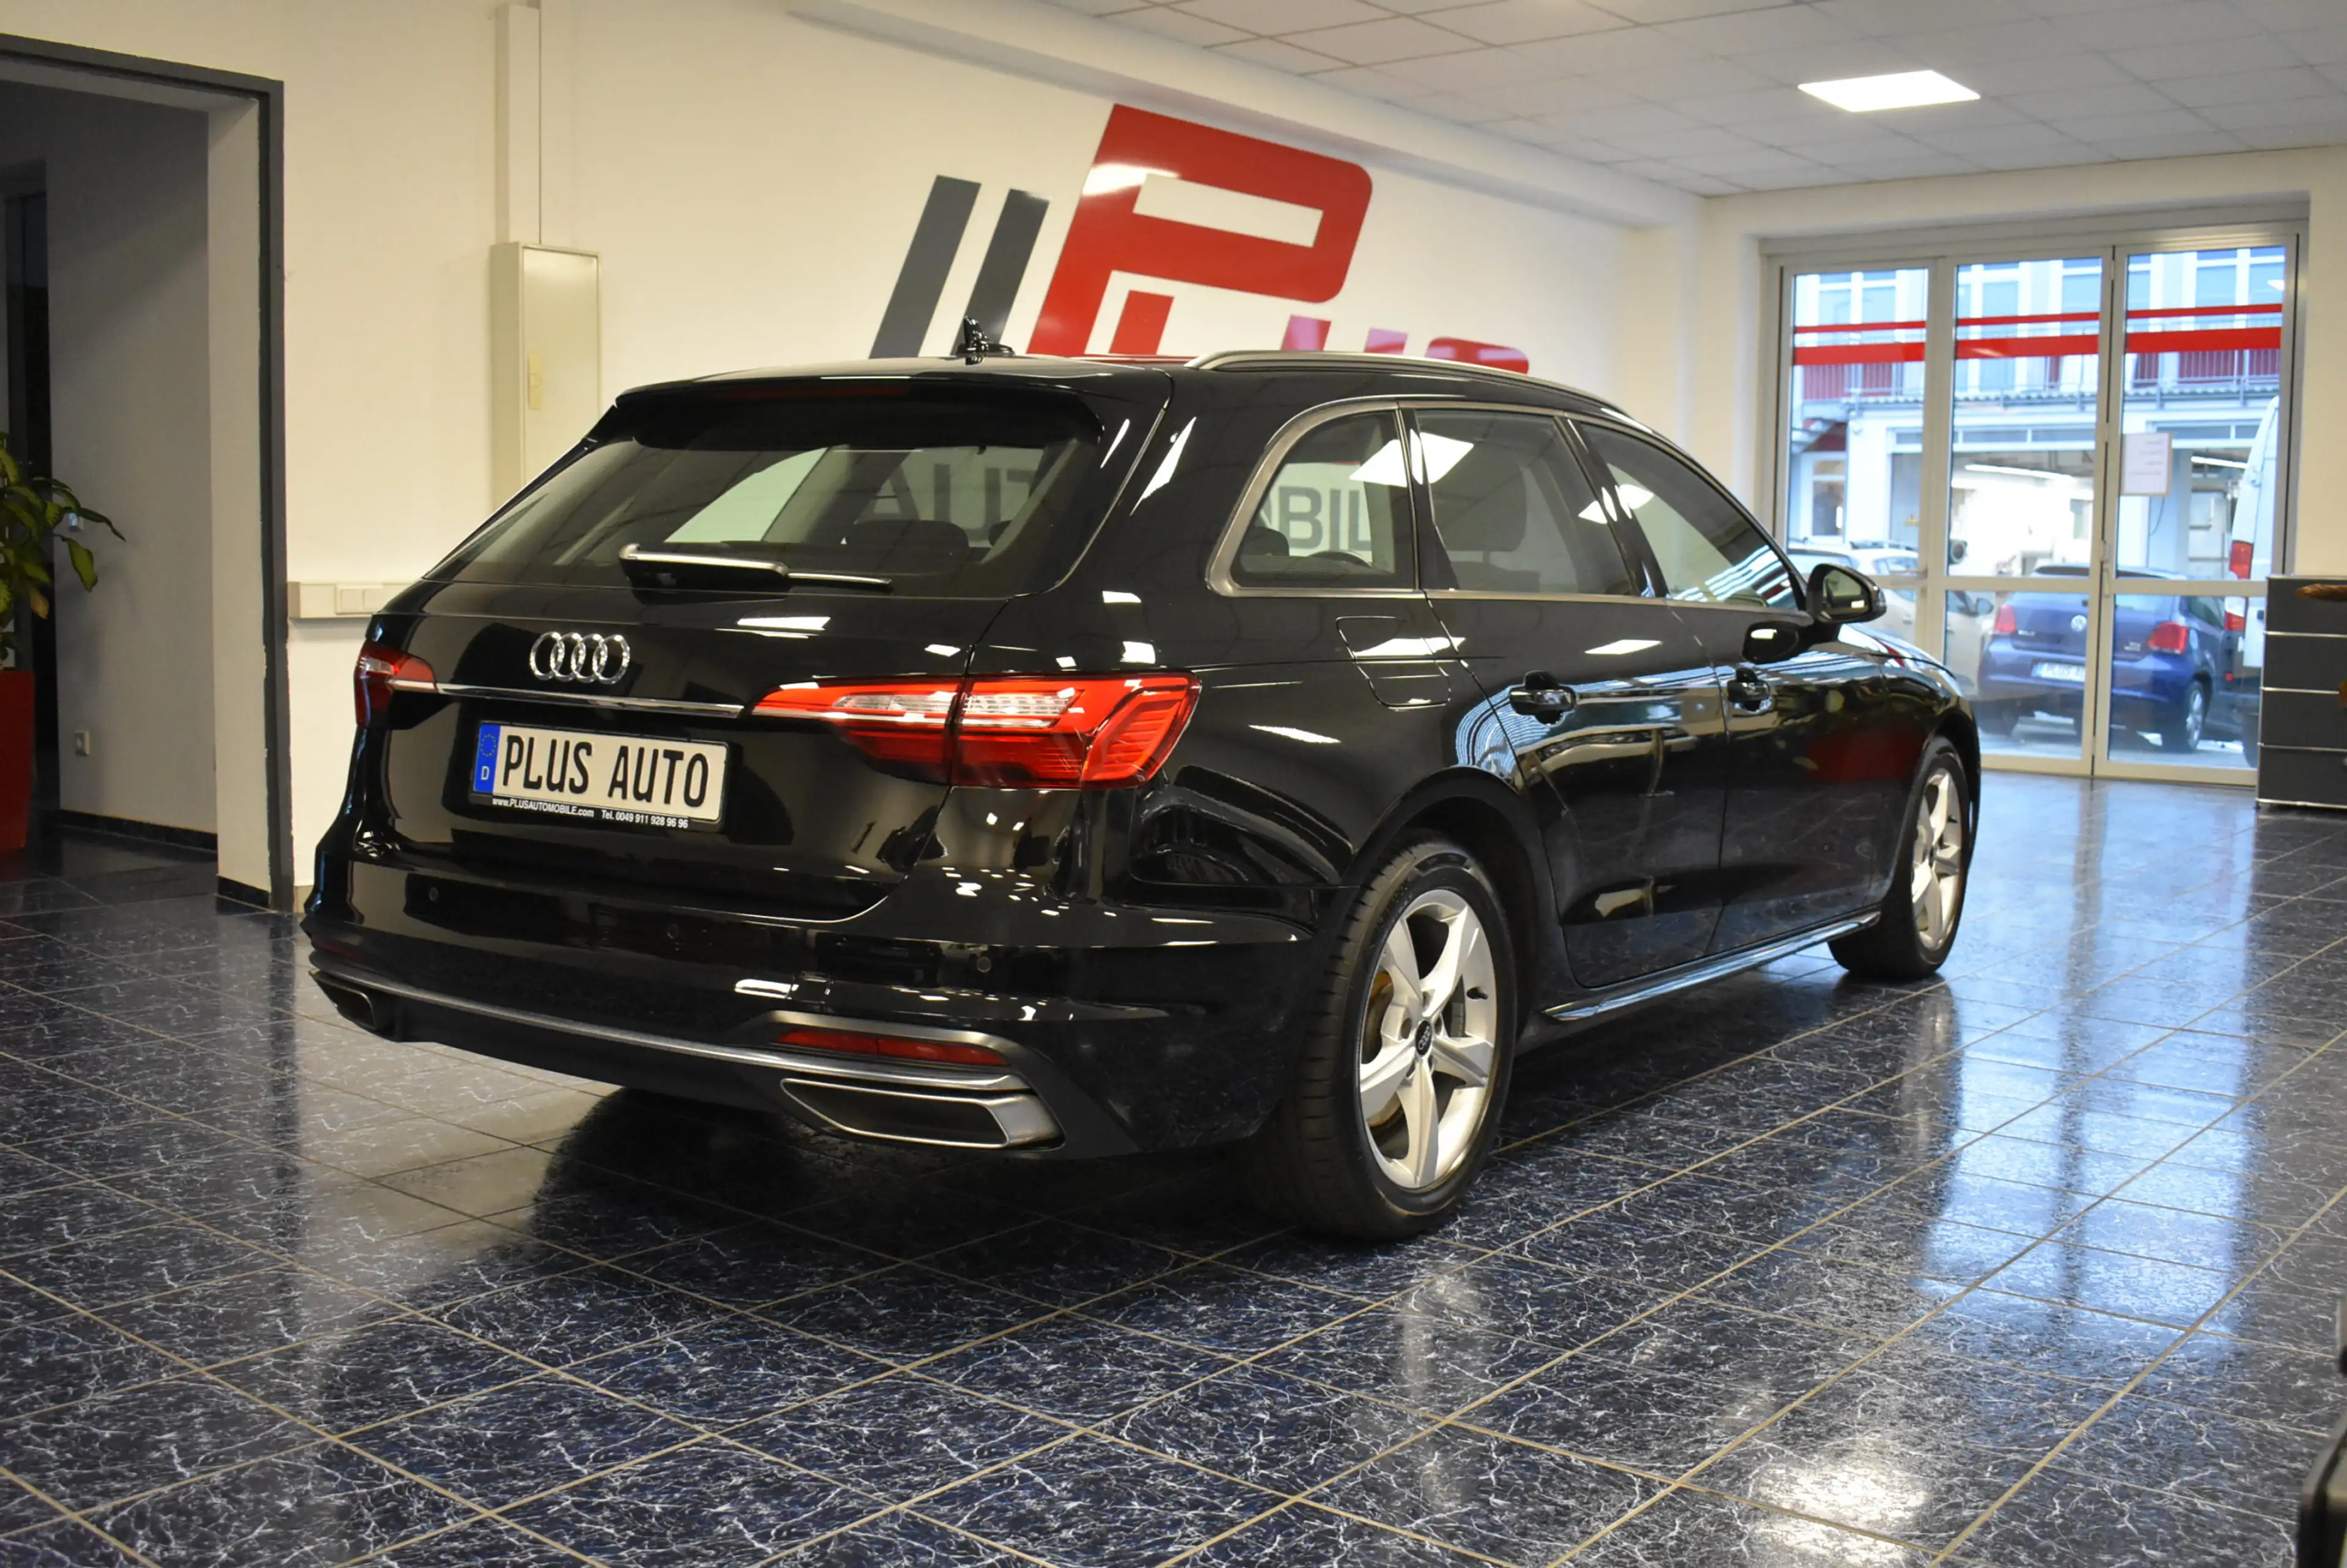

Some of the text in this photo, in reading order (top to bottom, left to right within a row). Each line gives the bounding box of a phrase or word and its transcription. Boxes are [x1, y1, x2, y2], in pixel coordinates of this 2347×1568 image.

[481, 766, 490, 780] D
[503, 735, 708, 807] PLUS AUTO
[492, 797, 689, 829] www.PLUSAUTOMOBILE.com Tel. 0049 911 928 96 96
